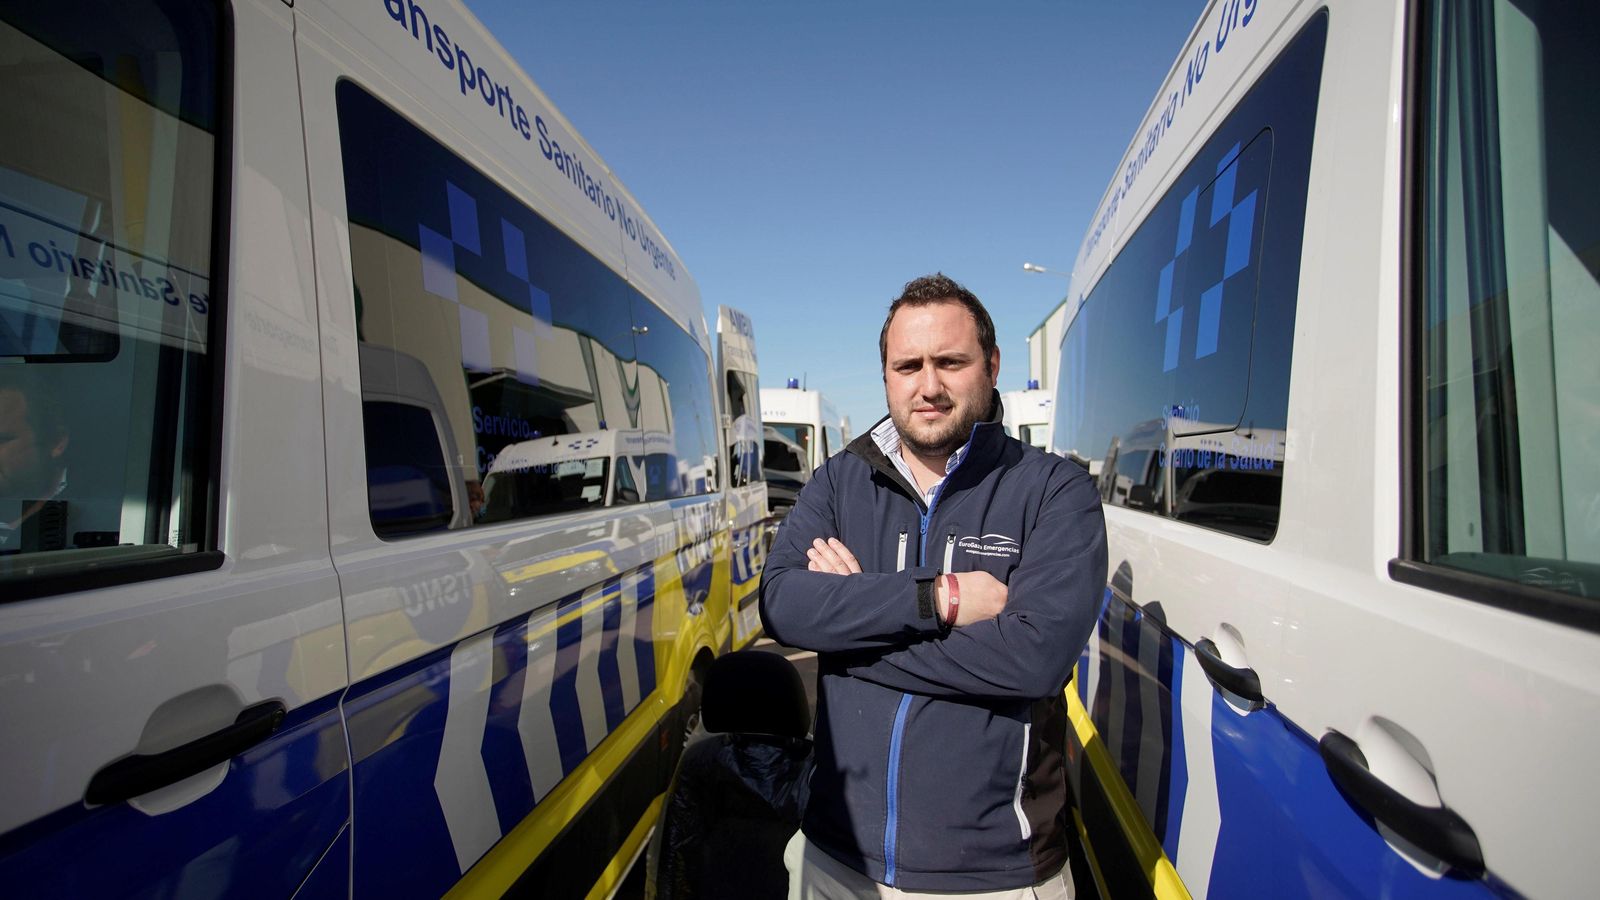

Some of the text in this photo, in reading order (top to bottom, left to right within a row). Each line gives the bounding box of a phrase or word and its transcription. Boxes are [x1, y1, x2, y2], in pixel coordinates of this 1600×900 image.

[1181, 41, 1210, 108] No
[535, 115, 615, 221] Sanitario
[615, 197, 636, 241] No
[635, 218, 676, 281] Urgente
[472, 406, 530, 439] Servicio
[1197, 440, 1211, 468] de
[1214, 442, 1225, 469] la
[1230, 432, 1276, 470] Salud
[983, 545, 1020, 554] Emergencias
